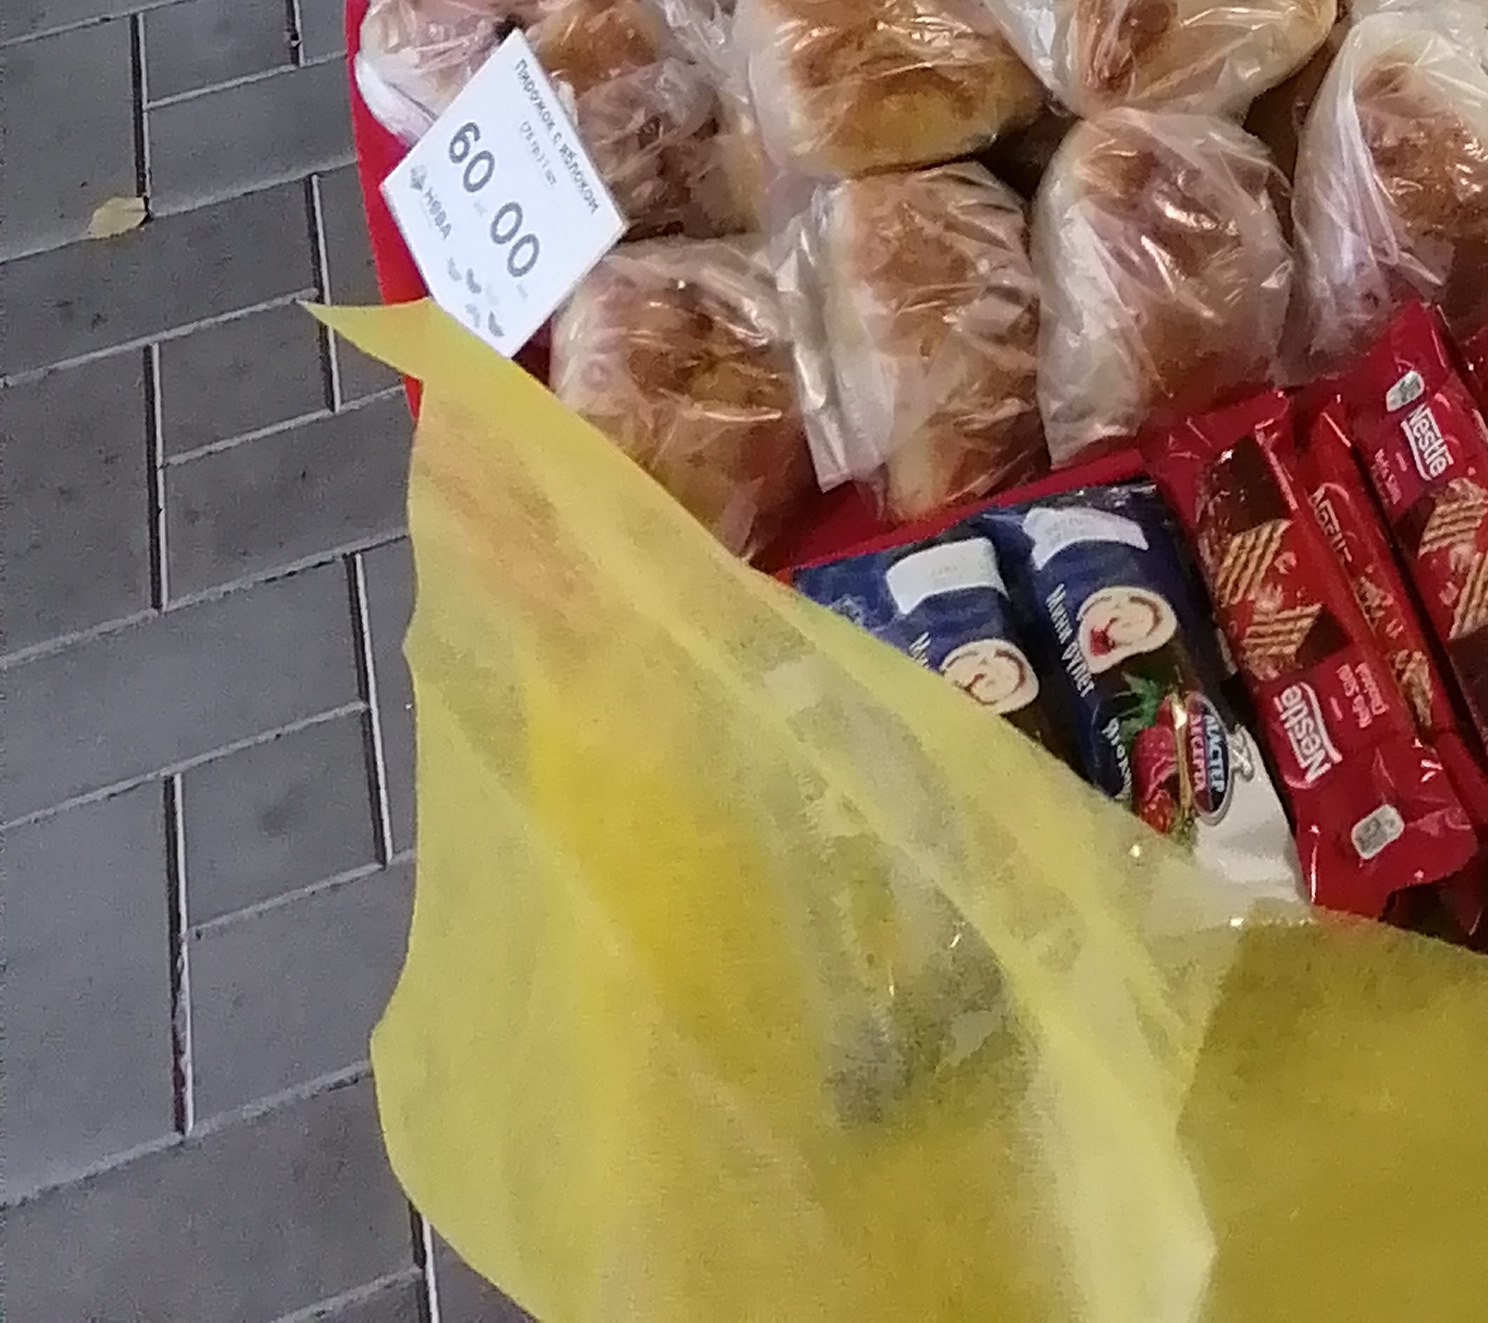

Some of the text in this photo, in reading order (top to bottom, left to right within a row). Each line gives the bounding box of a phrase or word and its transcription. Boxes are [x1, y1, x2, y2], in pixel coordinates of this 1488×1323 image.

[449, 121, 540, 278] 60 00
[514, 58, 601, 216] Пирожок с яблоком
[1046, 583, 1068, 645] Мини
